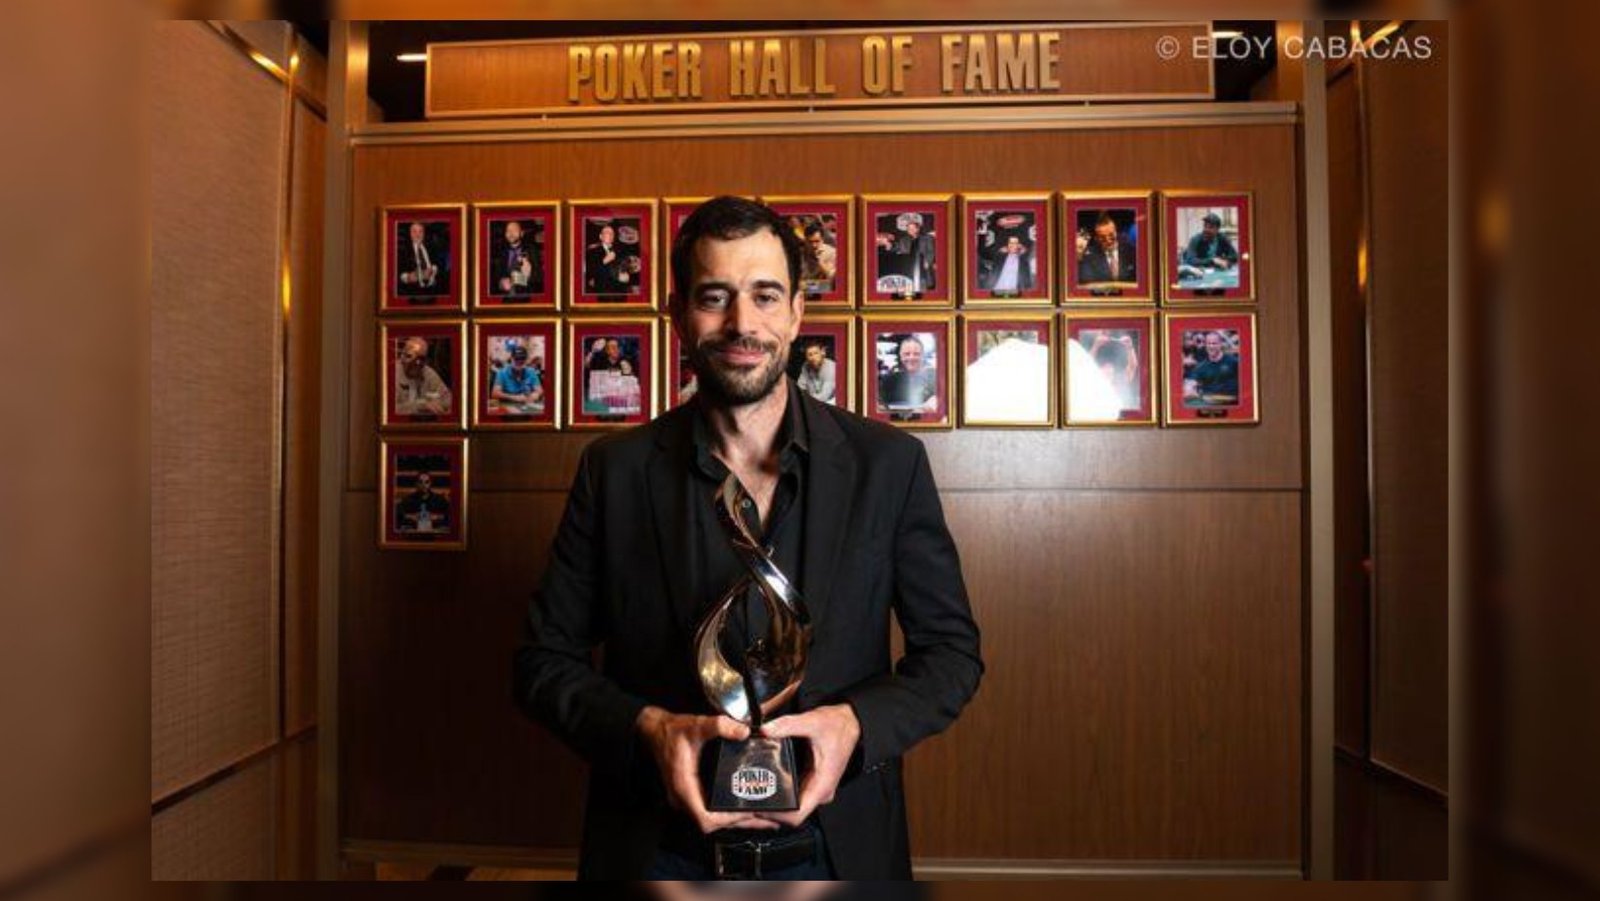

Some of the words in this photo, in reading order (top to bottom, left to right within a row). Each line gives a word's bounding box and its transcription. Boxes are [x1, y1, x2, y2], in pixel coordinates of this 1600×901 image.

[568, 43, 702, 102] POKER
[728, 38, 836, 97] HALL
[861, 35, 913, 95] OF
[940, 32, 1061, 93] FAME
